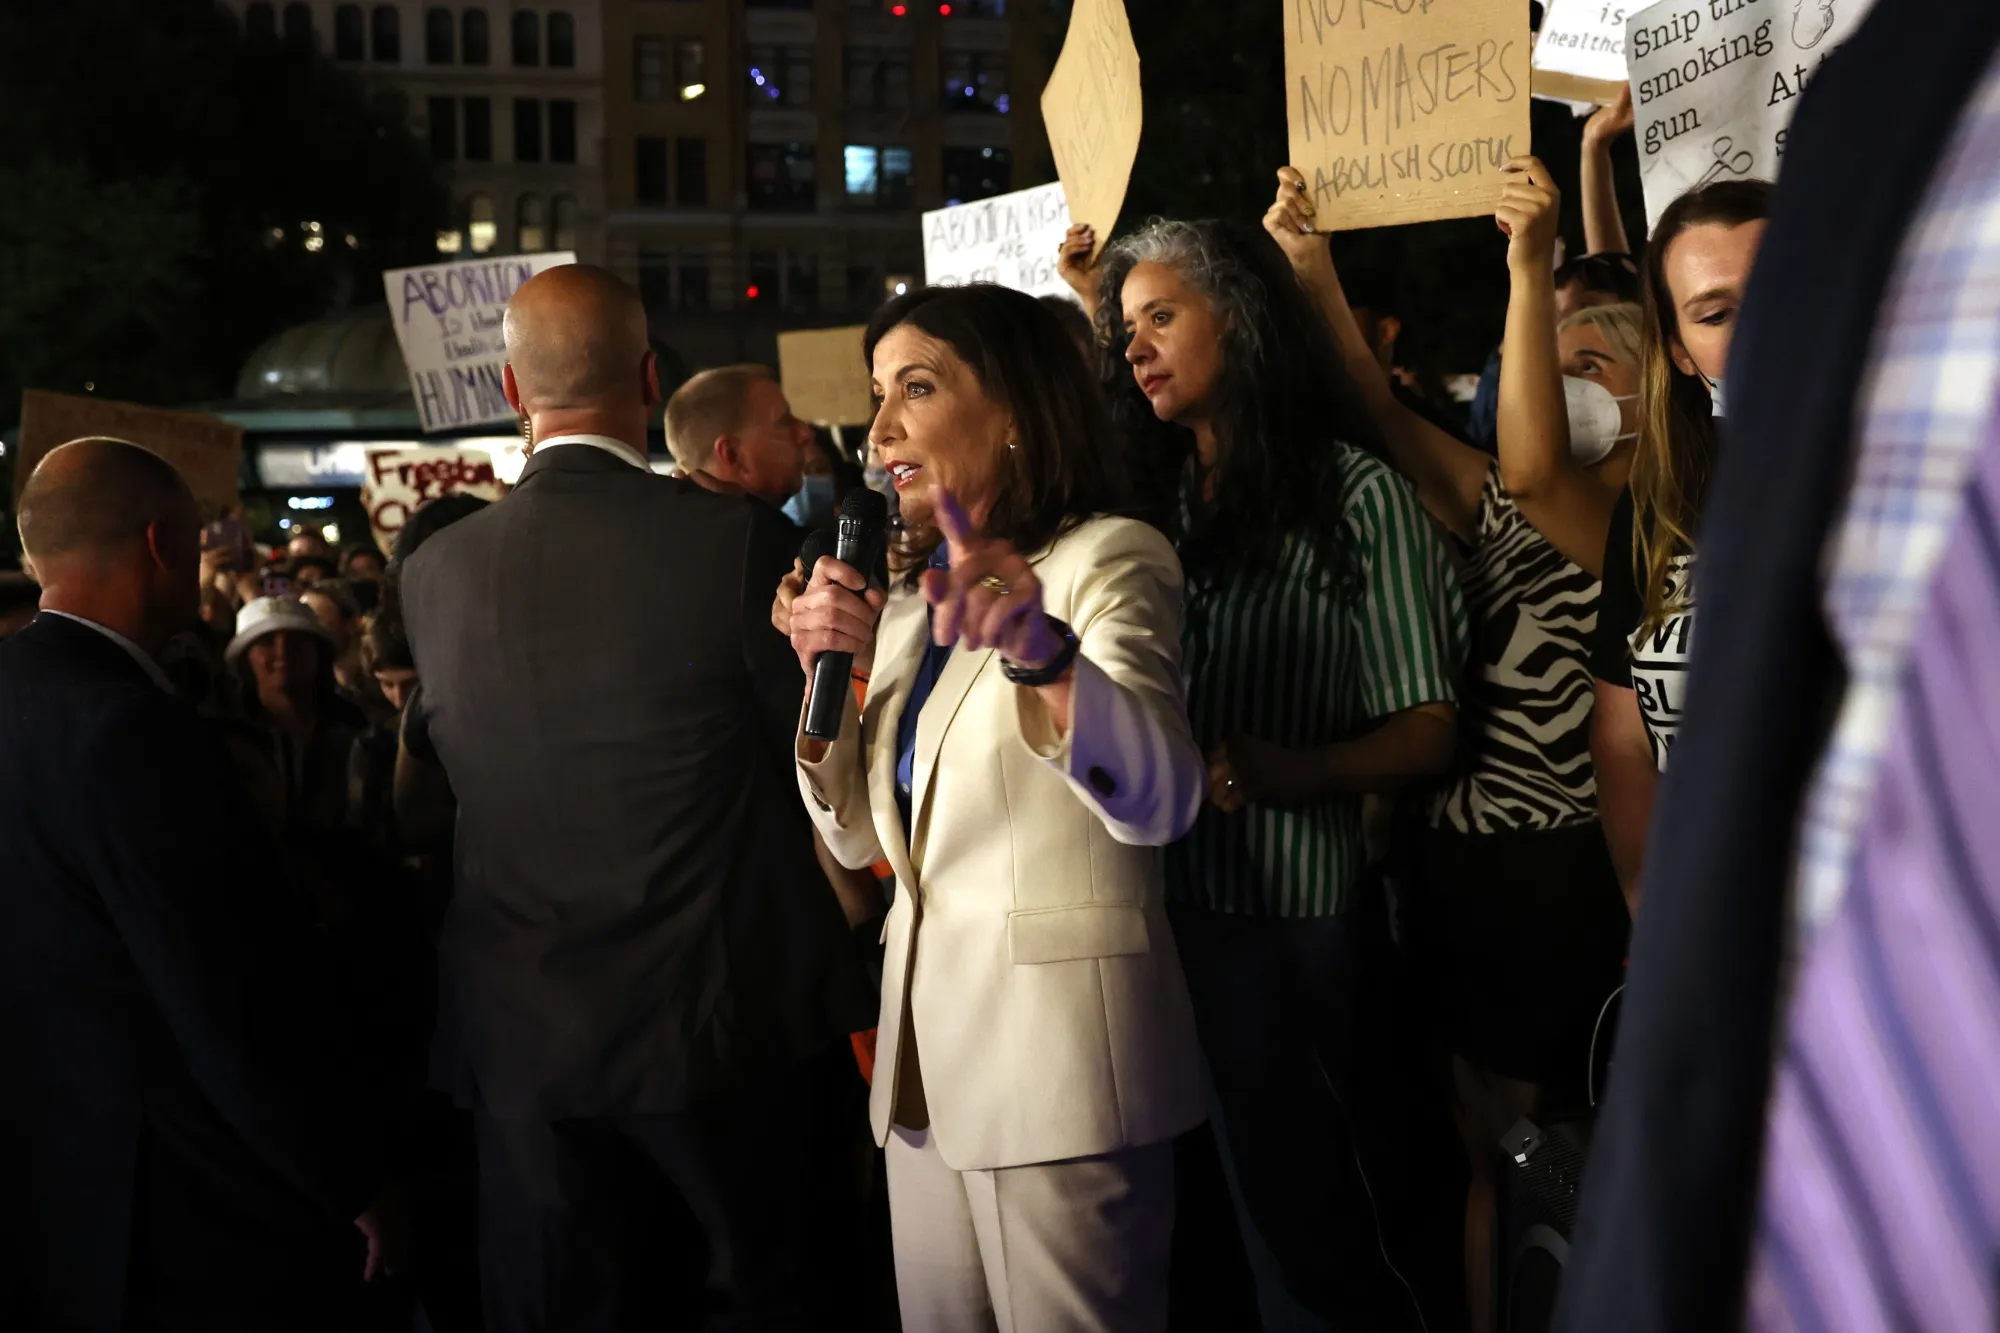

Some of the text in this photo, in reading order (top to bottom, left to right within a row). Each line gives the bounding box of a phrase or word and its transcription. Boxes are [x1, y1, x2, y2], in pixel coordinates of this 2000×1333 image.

[1600, 2, 1625, 26] is
[1633, 9, 1700, 61] Snip
[1639, 18, 1774, 105] smoking
[1767, 63, 1809, 107] At
[1299, 38, 1516, 146] NO MASTERS
[1645, 107, 1702, 156] gun
[1313, 143, 1422, 208] ABOLISH
[403, 261, 532, 323] ABORTION
